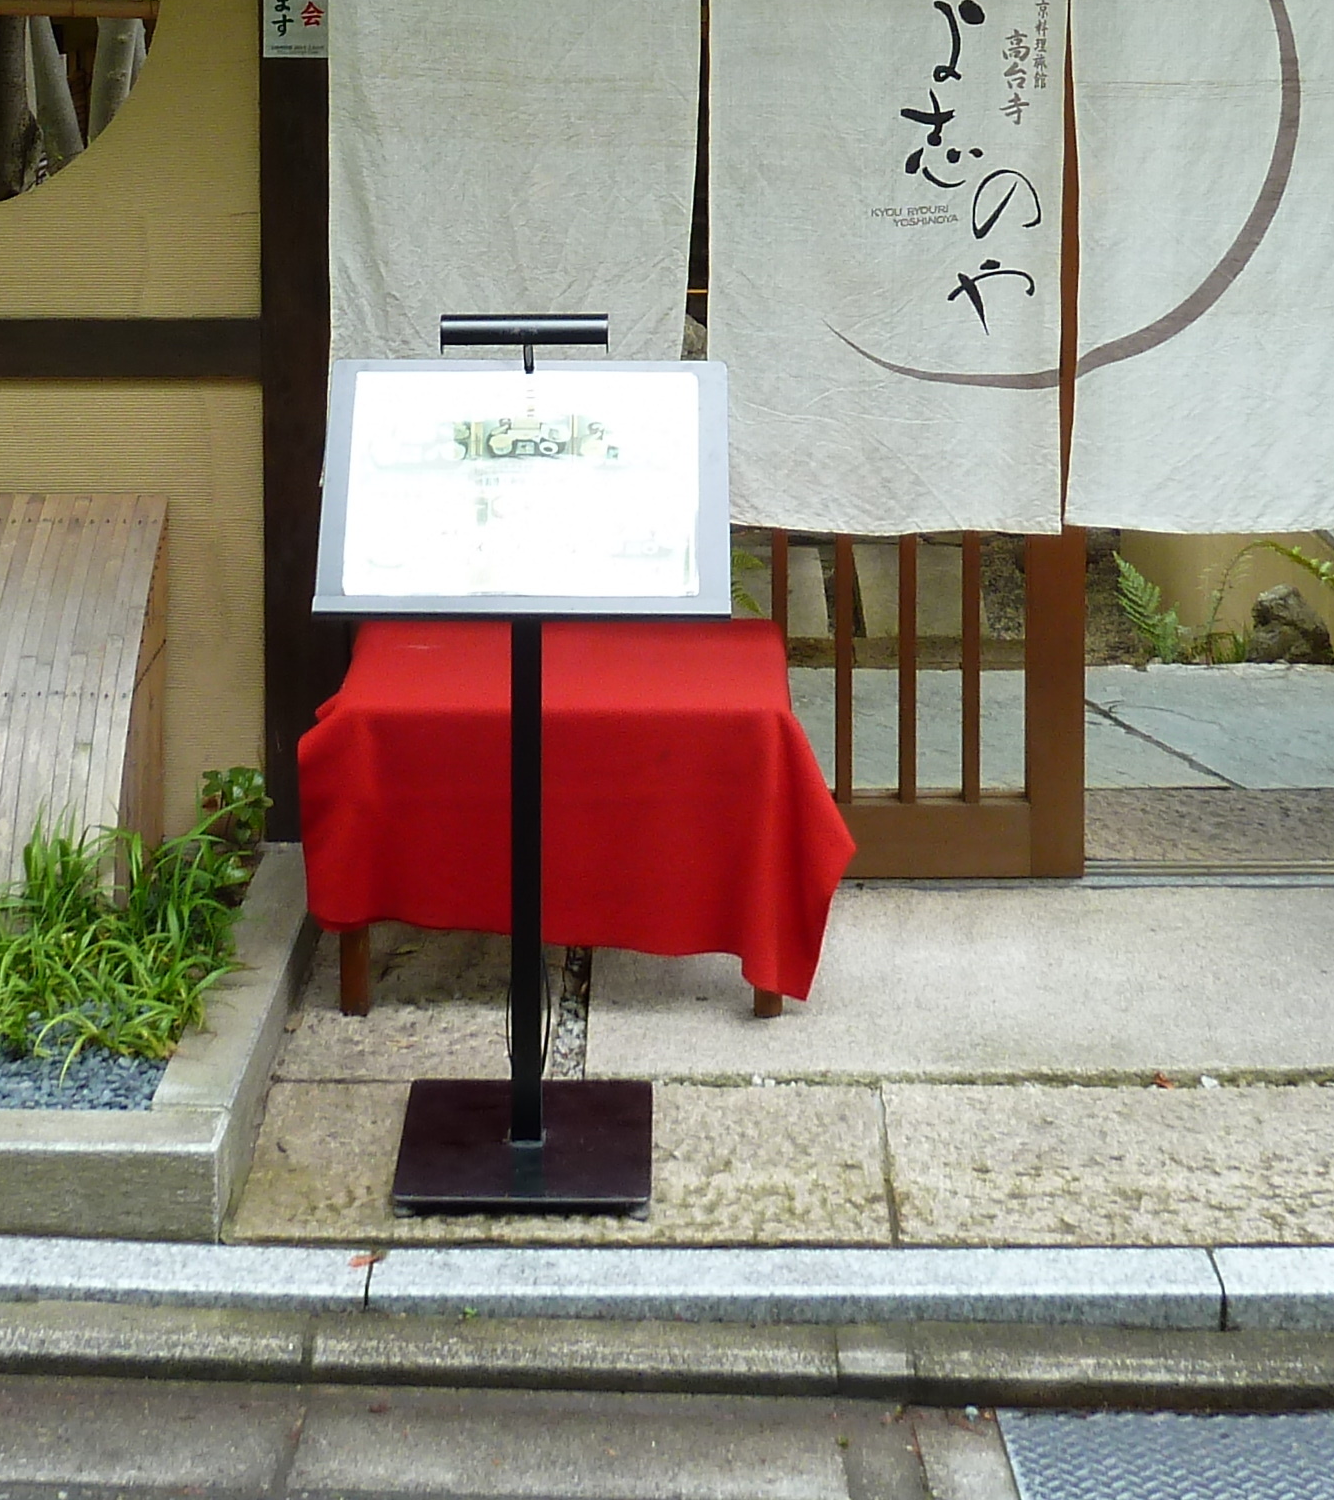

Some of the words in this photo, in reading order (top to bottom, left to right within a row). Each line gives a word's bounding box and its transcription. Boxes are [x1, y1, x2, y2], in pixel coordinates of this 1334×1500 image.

[1032, 0, 1050, 89] 京料理旅館
[999, 28, 1031, 126] 高台寺
[871, 208, 902, 217] KYOU
[907, 205, 949, 216] RYOURI
[893, 214, 959, 227] YOSHINOYA
